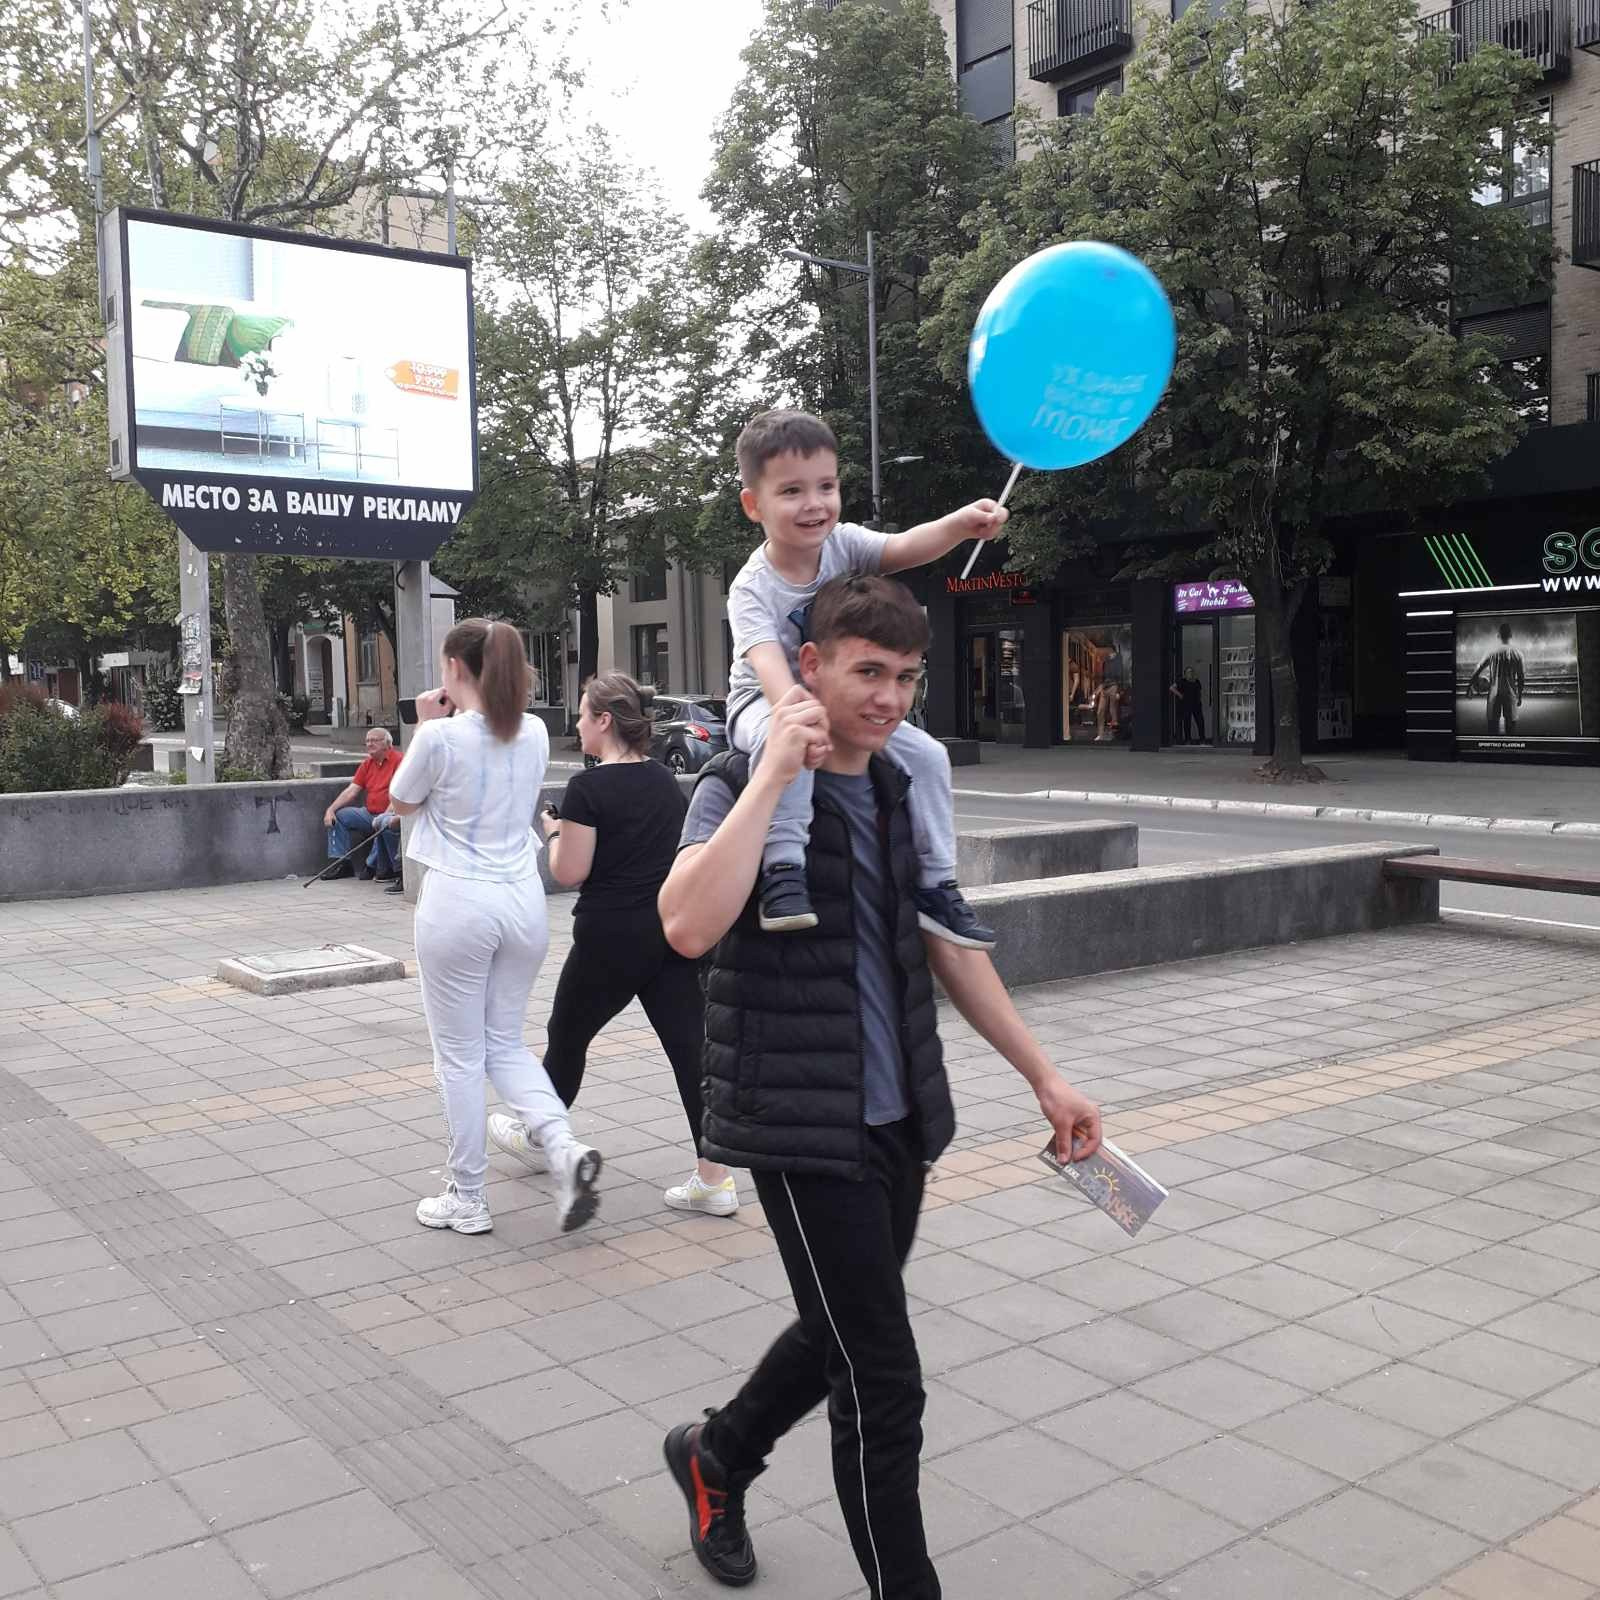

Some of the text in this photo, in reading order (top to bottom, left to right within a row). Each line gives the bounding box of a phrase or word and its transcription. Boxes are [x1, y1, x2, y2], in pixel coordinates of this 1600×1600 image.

[161, 483, 462, 524] МЕСТО ЗА ВАШУ РЕКЛАМУ
[1200, 596, 1229, 608] Mobile
